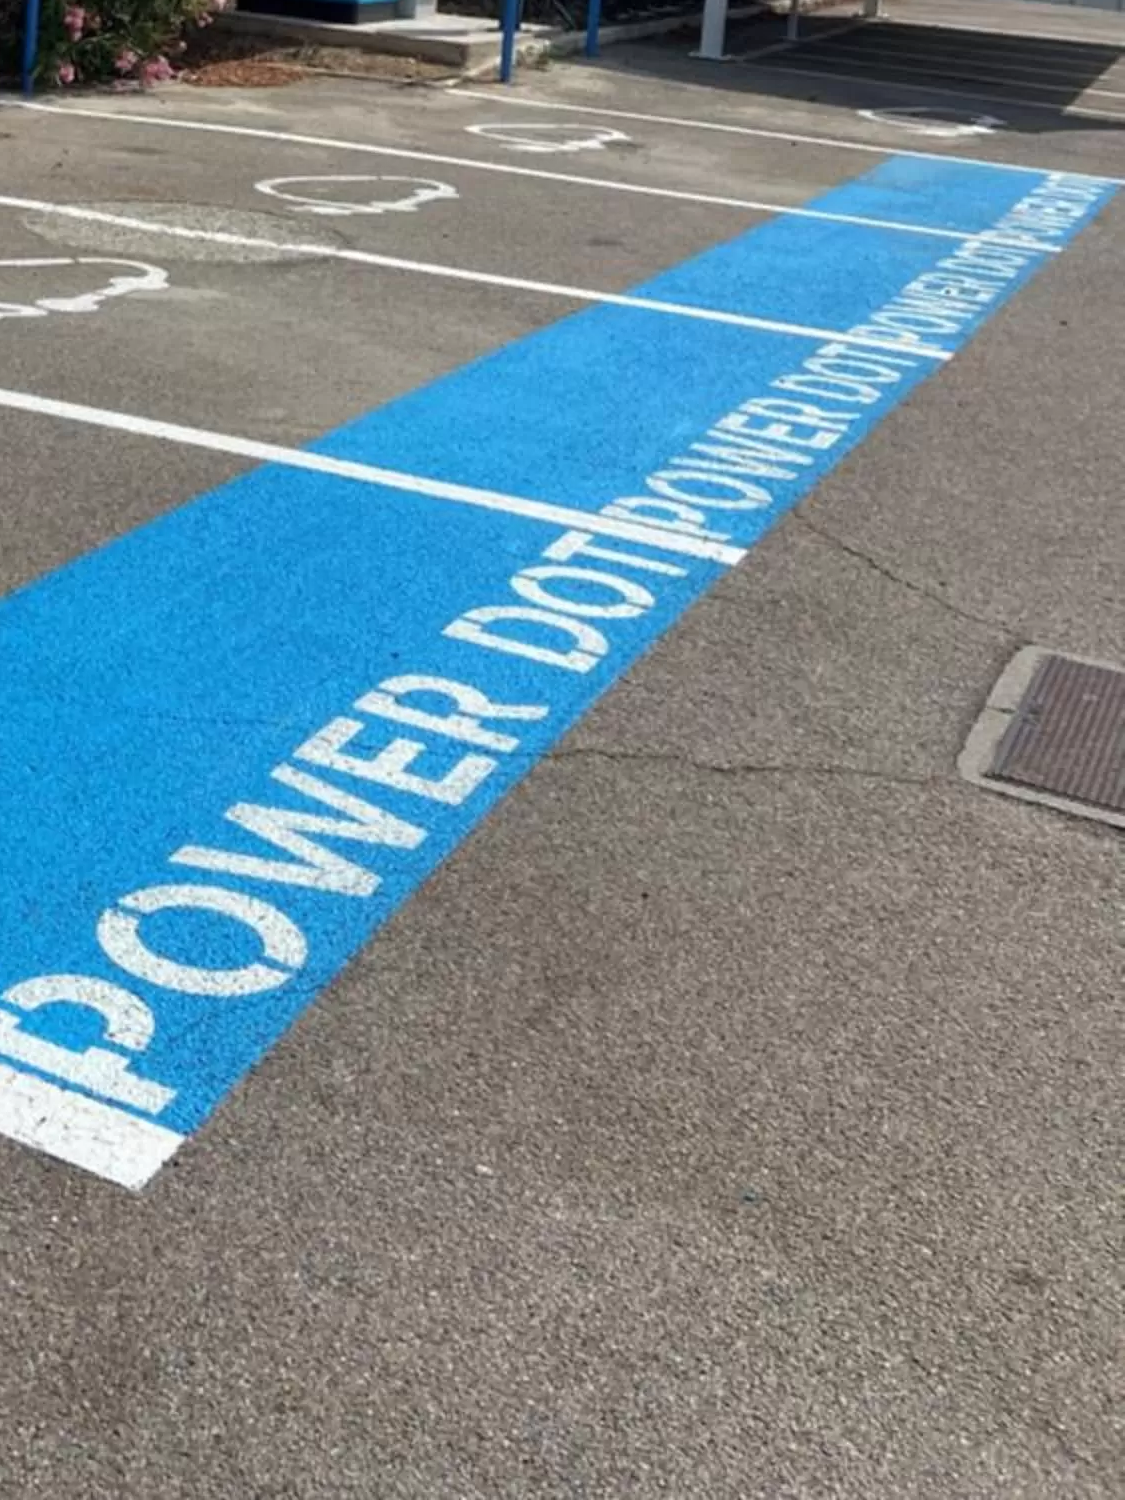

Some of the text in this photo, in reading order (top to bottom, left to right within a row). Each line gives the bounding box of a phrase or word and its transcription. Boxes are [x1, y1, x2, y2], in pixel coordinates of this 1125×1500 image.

[847, 240, 1039, 350] POWER DOT
[599, 342, 918, 540] POWER DOT
[441, 530, 689, 673] DOT
